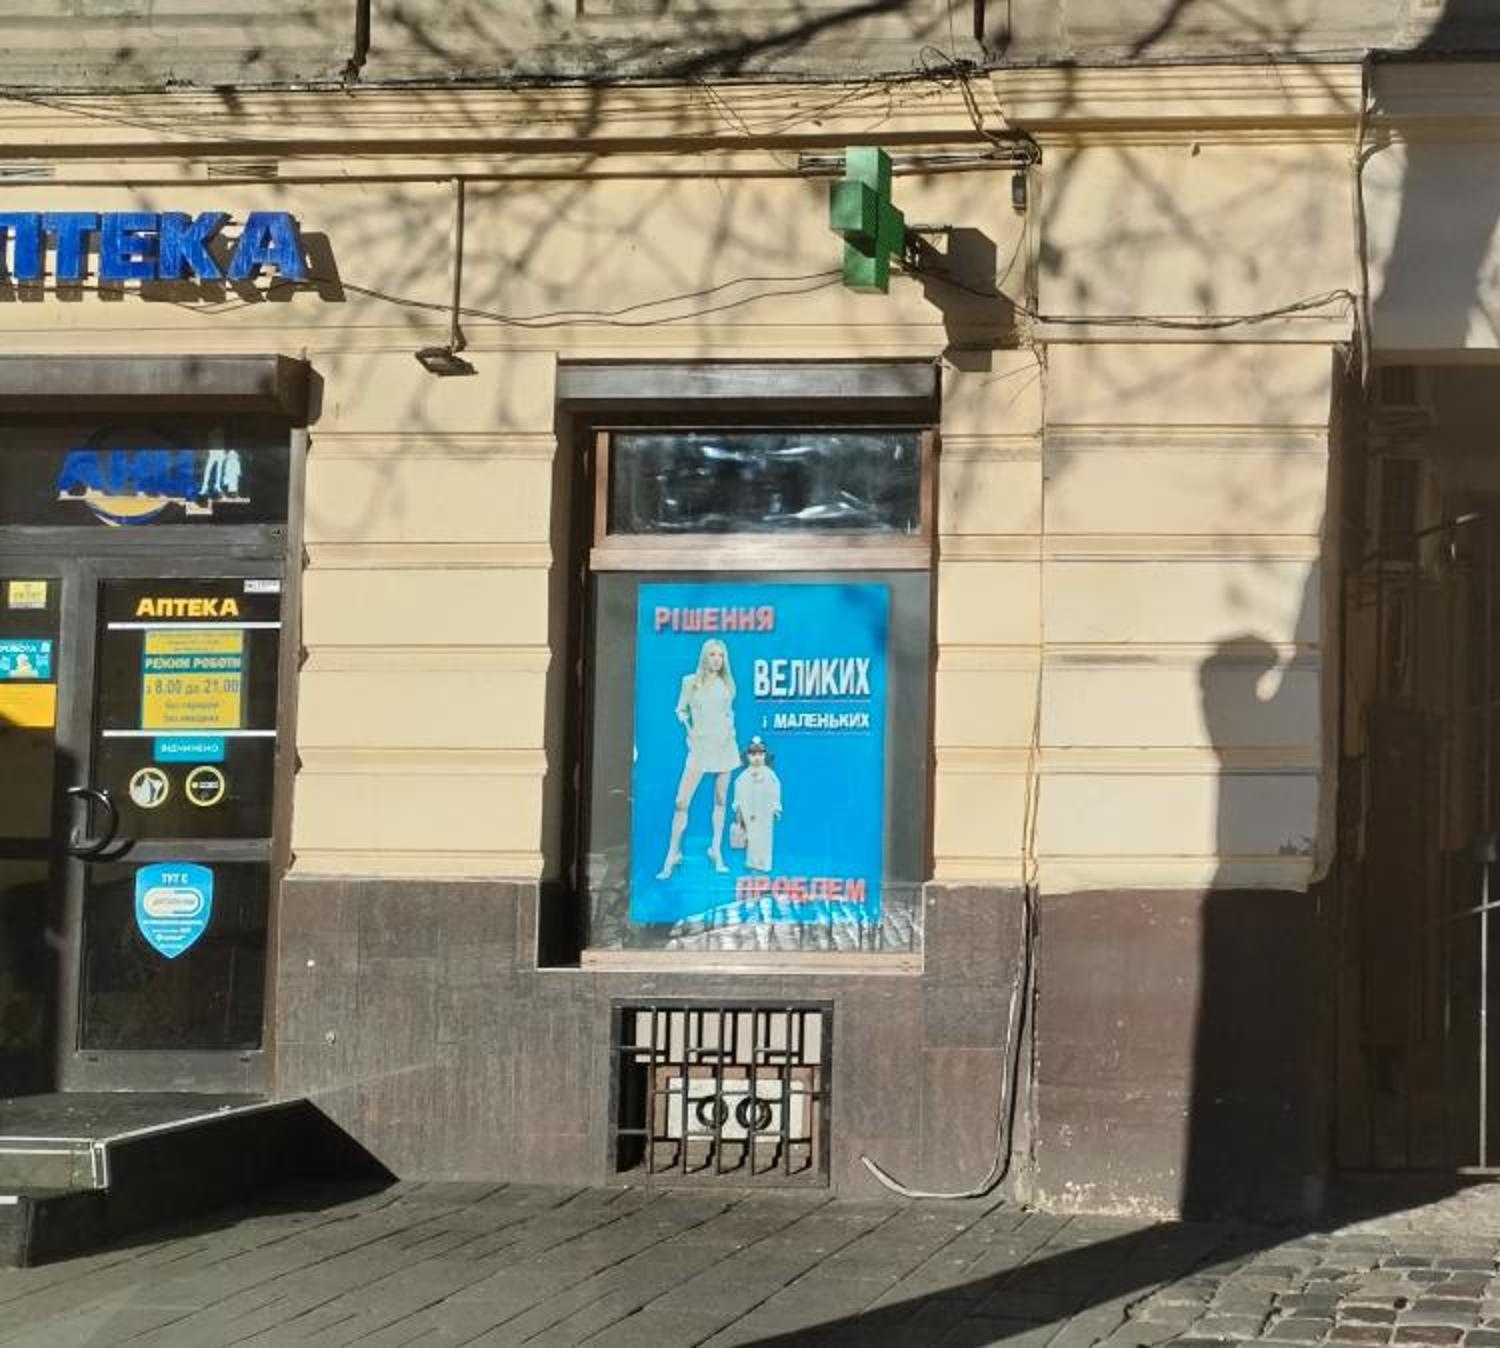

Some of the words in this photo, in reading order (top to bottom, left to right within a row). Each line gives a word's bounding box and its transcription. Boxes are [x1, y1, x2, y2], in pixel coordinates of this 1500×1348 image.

[136, 597, 240, 617] АПТЕКА
[655, 605, 774, 633] РІШЕННЯ
[754, 657, 870, 697] ВЕЛИКИХ
[773, 713, 870, 730] МАЛЕНЬКИХ
[161, 743, 219, 753] ВІДЧИНЕНО
[736, 876, 866, 902] ПРОБЛЕМ
